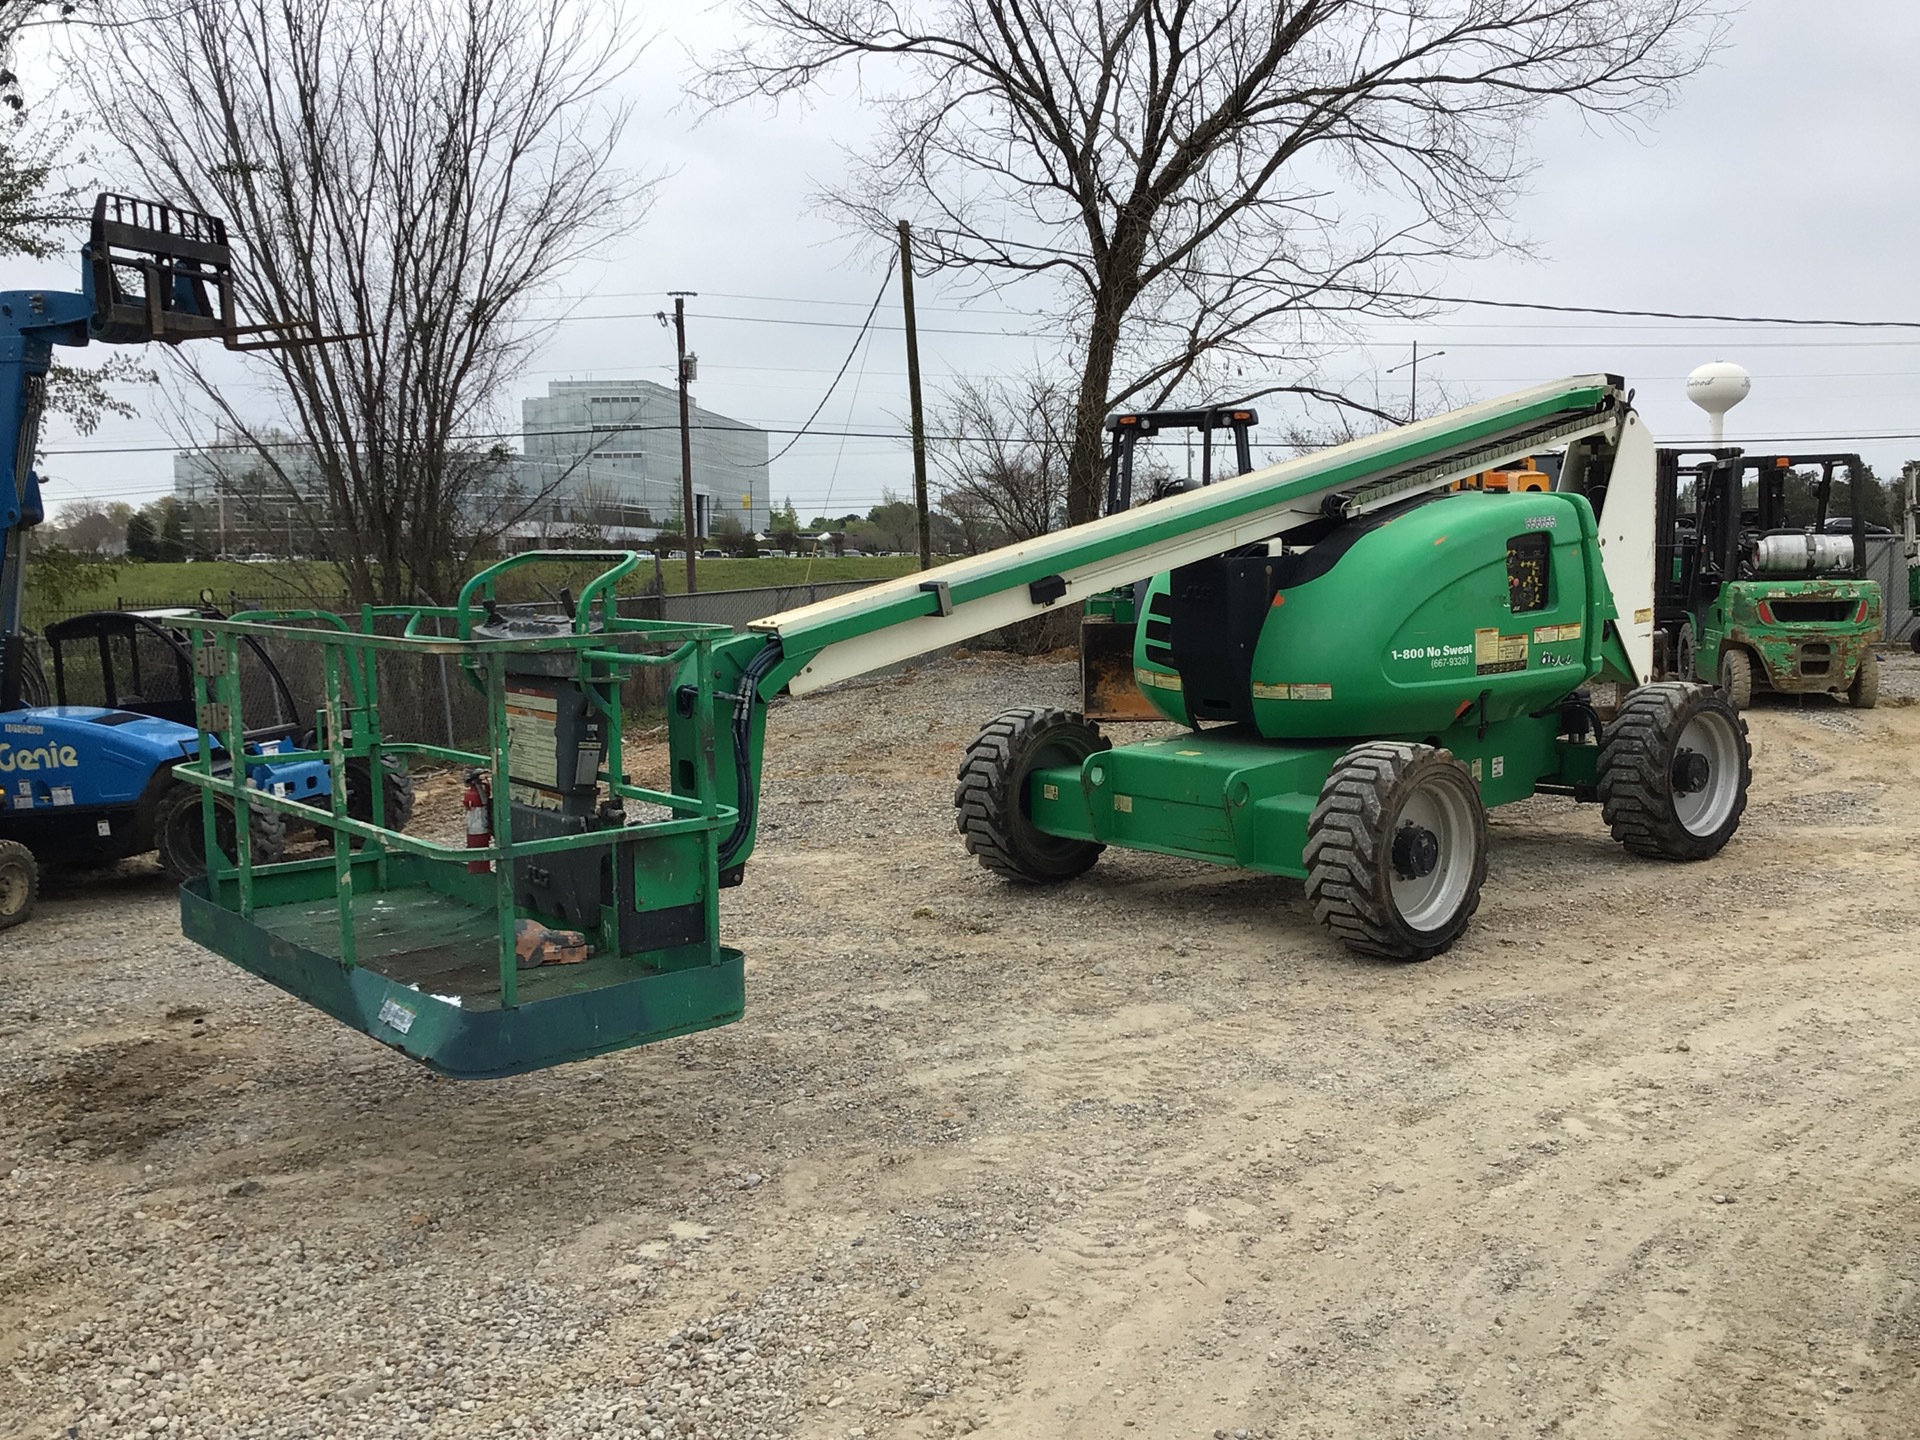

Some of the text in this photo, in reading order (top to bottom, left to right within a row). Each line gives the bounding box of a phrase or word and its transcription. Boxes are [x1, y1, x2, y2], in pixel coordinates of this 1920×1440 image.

[1391, 644, 1473, 660] 1-800 No Sweat
[1431, 655, 1469, 669] (667-9328)
[0, 740, 78, 772] Genie
